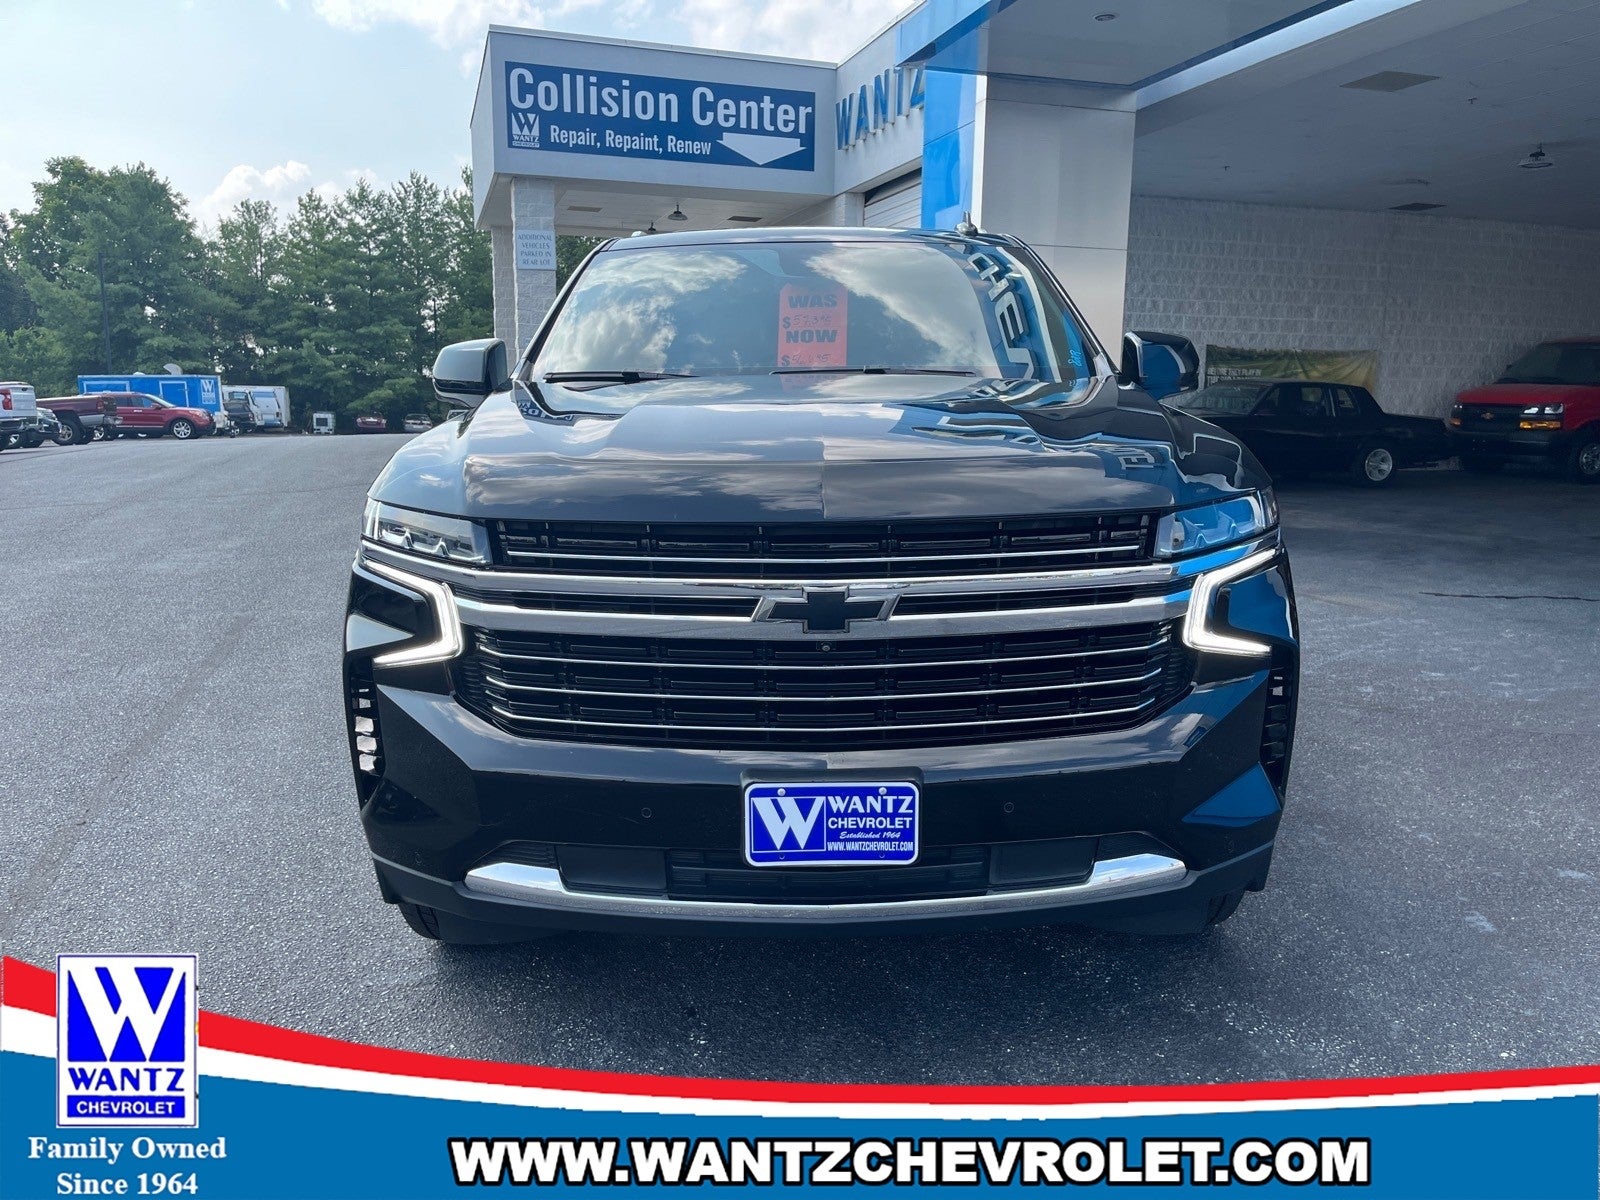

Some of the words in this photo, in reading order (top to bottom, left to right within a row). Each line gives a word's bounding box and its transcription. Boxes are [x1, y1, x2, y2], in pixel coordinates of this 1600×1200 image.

[509, 67, 679, 122] Collision
[692, 86, 812, 134] Center
[835, 66, 925, 151] WANTZ
[512, 134, 540, 143] WANTZ
[550, 124, 600, 149] Repair,
[605, 129, 663, 154] Repaint,
[667, 135, 712, 155] Renew
[517, 233, 553, 241] ADDITIONAL
[788, 294, 838, 309] WAS
[785, 329, 839, 344] NOW
[827, 795, 914, 814] WANTZ
[753, 797, 826, 850] W
[827, 817, 913, 829] CHEVROLET
[839, 831, 881, 839] Established
[882, 831, 901, 839] 1964
[827, 841, 914, 851] WWW.WANTZCHEVROLET.COM
